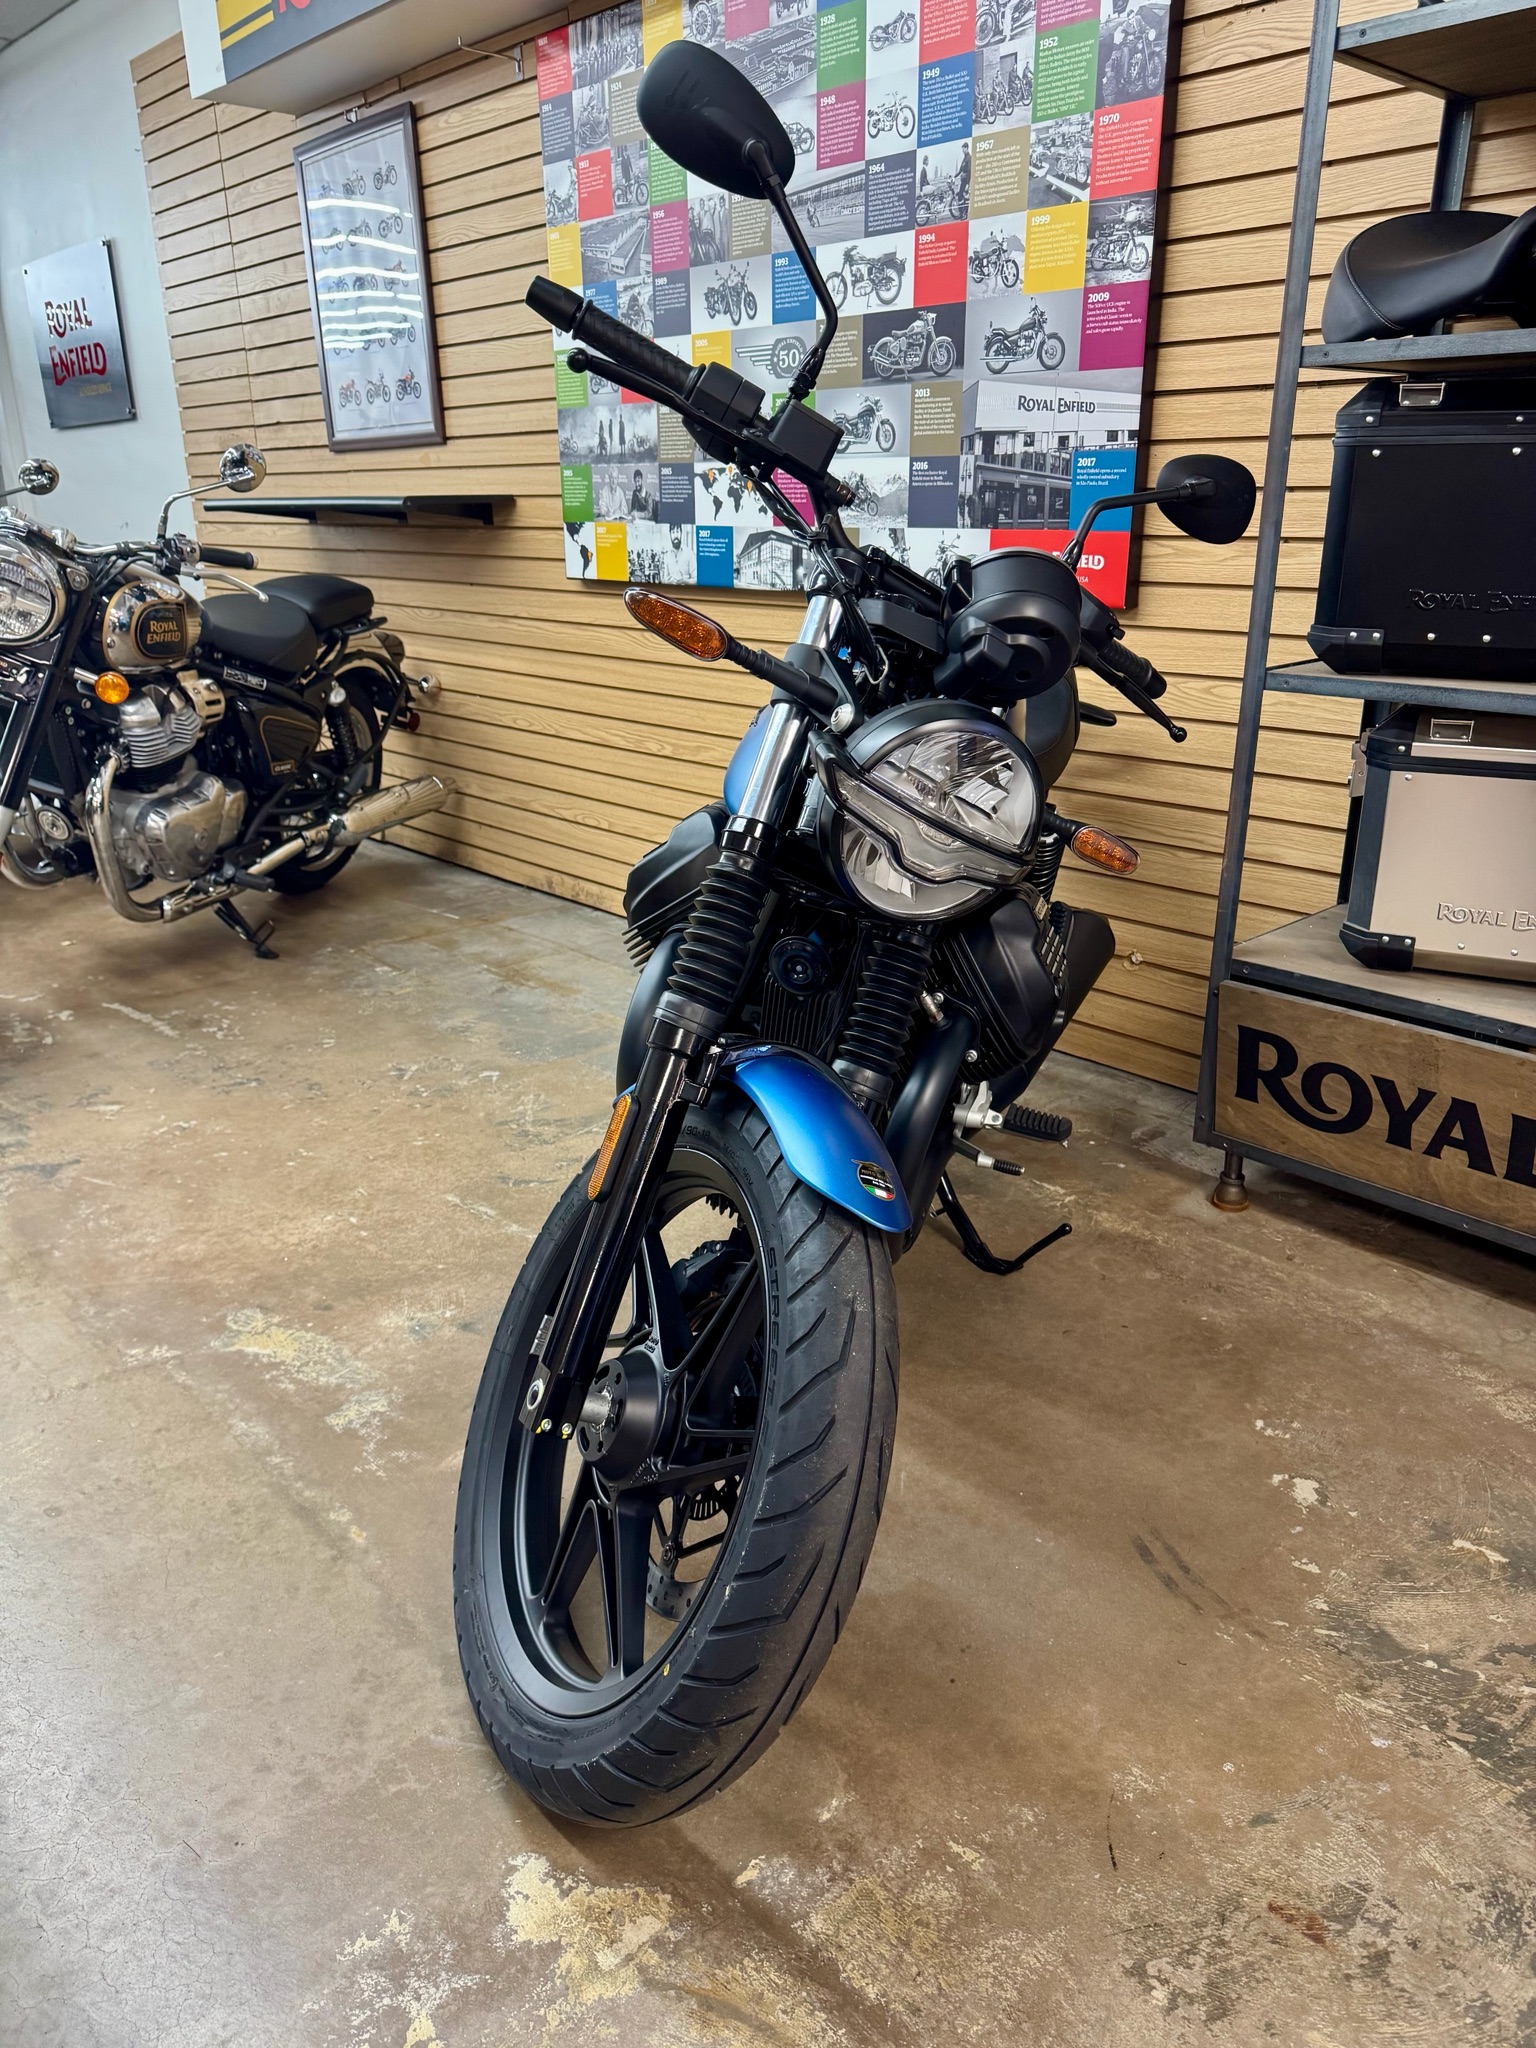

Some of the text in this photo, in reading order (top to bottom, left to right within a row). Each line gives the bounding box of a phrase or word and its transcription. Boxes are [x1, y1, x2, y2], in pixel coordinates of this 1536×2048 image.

[820, 14, 836, 26] 1928
[1039, 37, 1058, 49] 1952
[922, 67, 940, 80] 1949
[820, 95, 836, 106] 1948
[1099, 112, 1120, 126] 1970
[976, 140, 994, 152] 1967
[869, 163, 885, 174] 1964
[1031, 214, 1050, 226] 1999
[919, 232, 935, 244] 1994
[775, 257, 788, 266] 1993
[1088, 292, 1110, 303] 2009
[45, 297, 92, 338] ROYAL
[49, 342, 107, 386] ENFIELD
[779, 349, 799, 368] 50
[915, 388, 930, 397] 2013
[1018, 395, 1096, 413] ROYAL ENFIELD
[1077, 457, 1096, 467] 2017
[1409, 588, 1480, 610] ROYAL
[150, 620, 178, 633] ROYAL
[146, 631, 181, 645] ENFIELD
[1437, 902, 1508, 927] ROYAL
[1234, 1024, 1536, 1187] ROYAL
